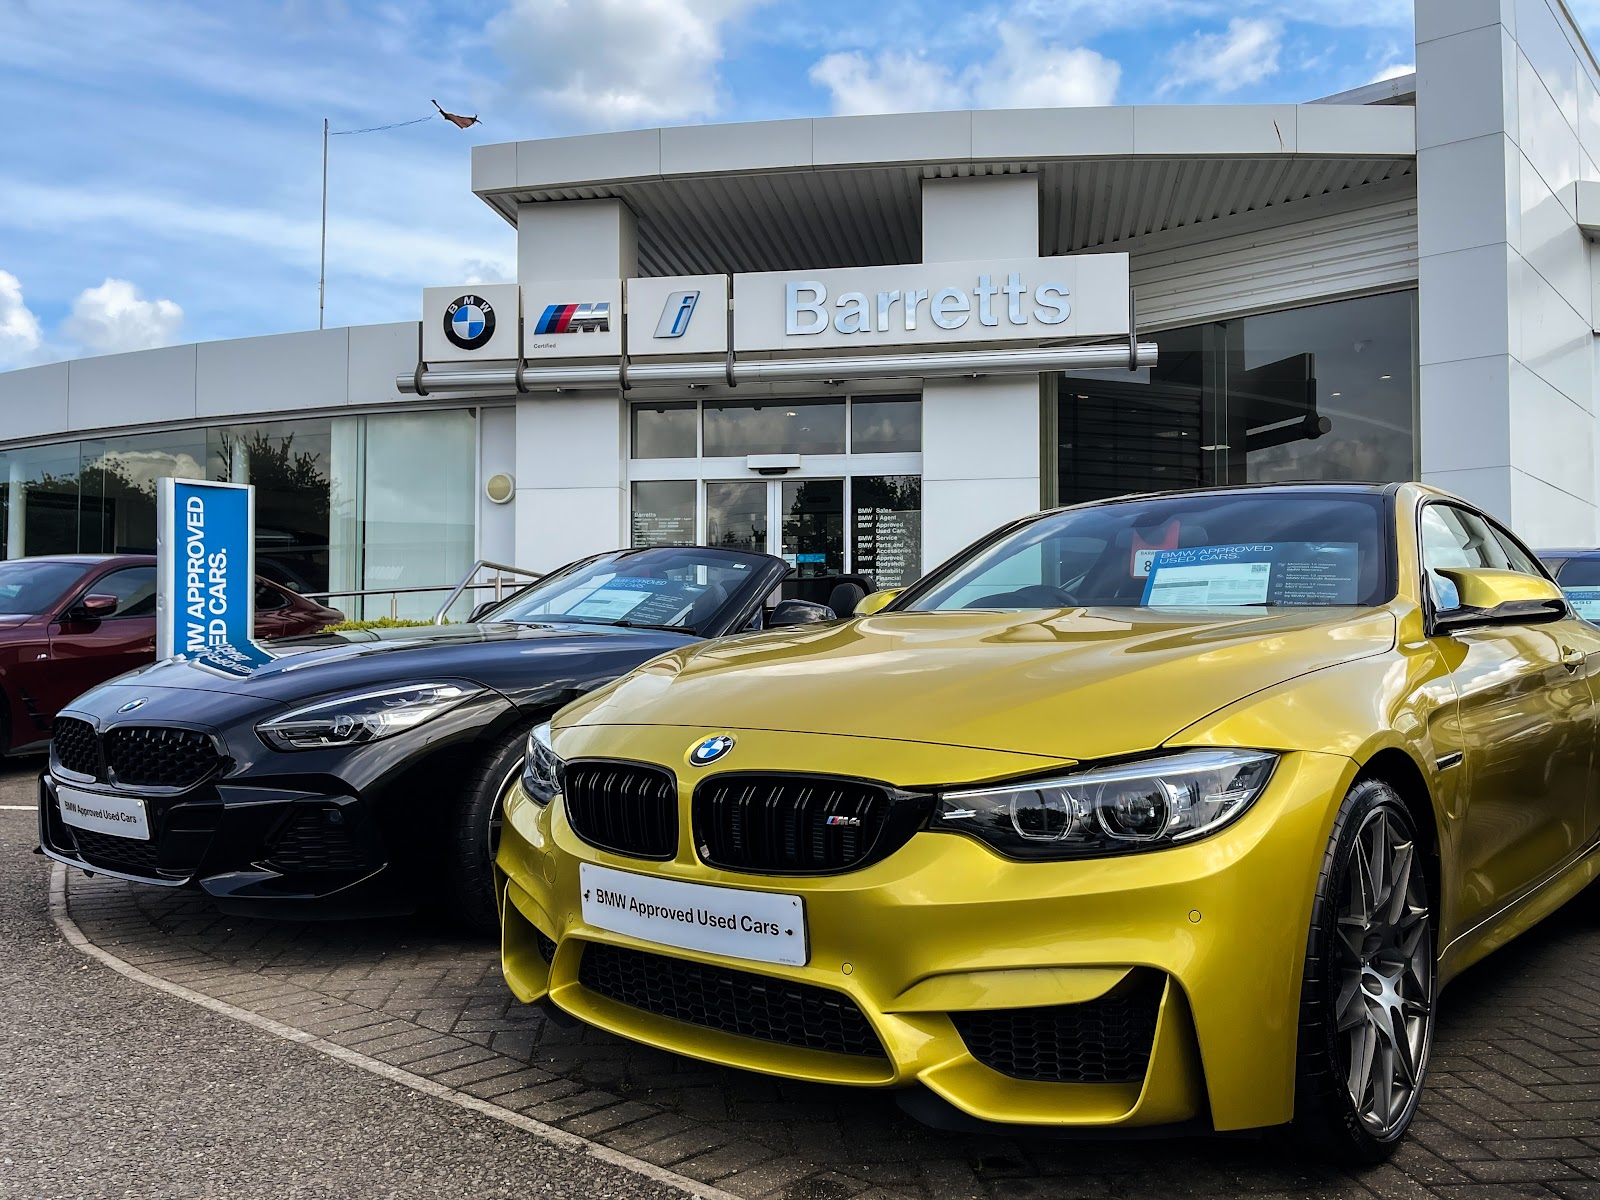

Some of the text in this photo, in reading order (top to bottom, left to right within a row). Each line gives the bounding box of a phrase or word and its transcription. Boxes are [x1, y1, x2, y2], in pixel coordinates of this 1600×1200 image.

[785, 272, 1072, 336] Barretts
[186, 496, 205, 620] APPROVED
[1159, 553, 1241, 565] USED CARS.
[1161, 545, 1274, 559] BMW APPROVED
[208, 548, 228, 615] CARS.
[64, 800, 137, 824] BMW Approved Used Cars
[596, 888, 780, 936] BMW Approved Used Cars
